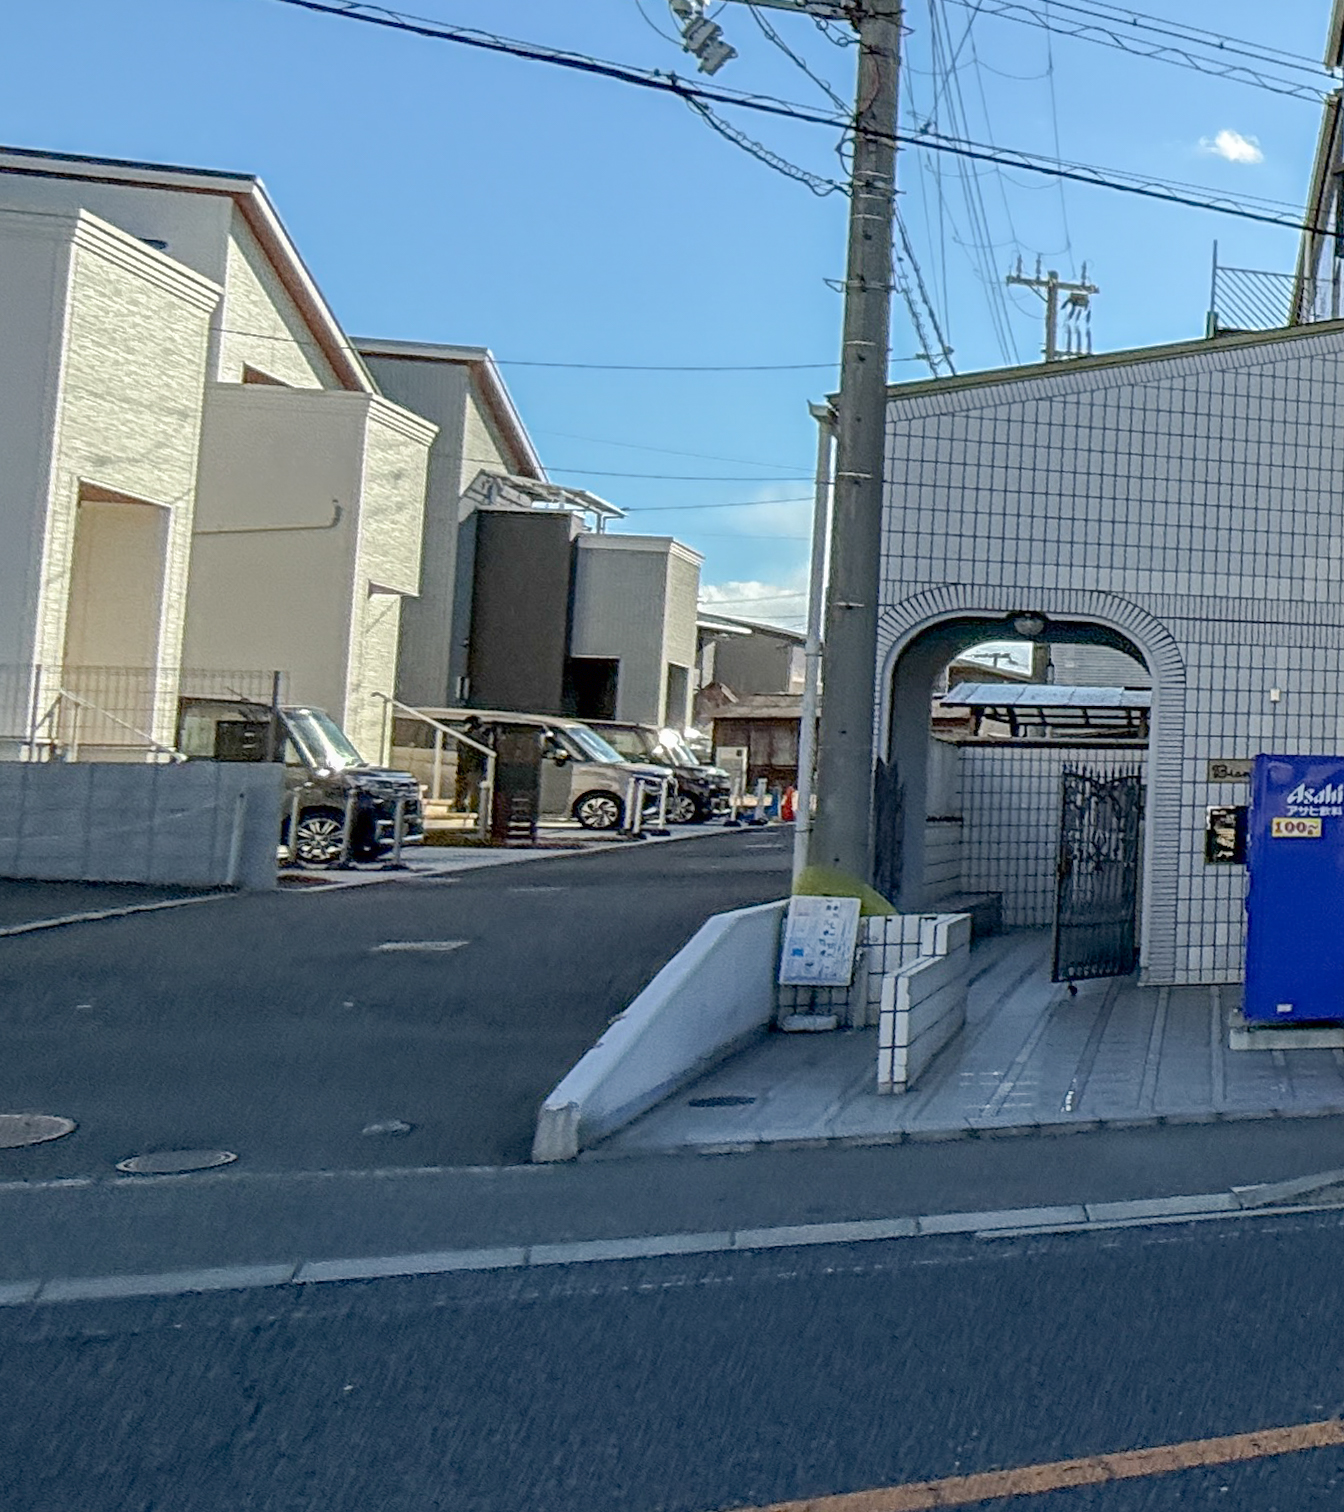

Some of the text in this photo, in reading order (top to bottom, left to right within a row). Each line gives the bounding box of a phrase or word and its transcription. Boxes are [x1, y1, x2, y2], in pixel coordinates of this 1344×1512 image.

[1287, 783, 1344, 804] Asahi
[1286, 805, 1343, 817] アサヒ飲料
